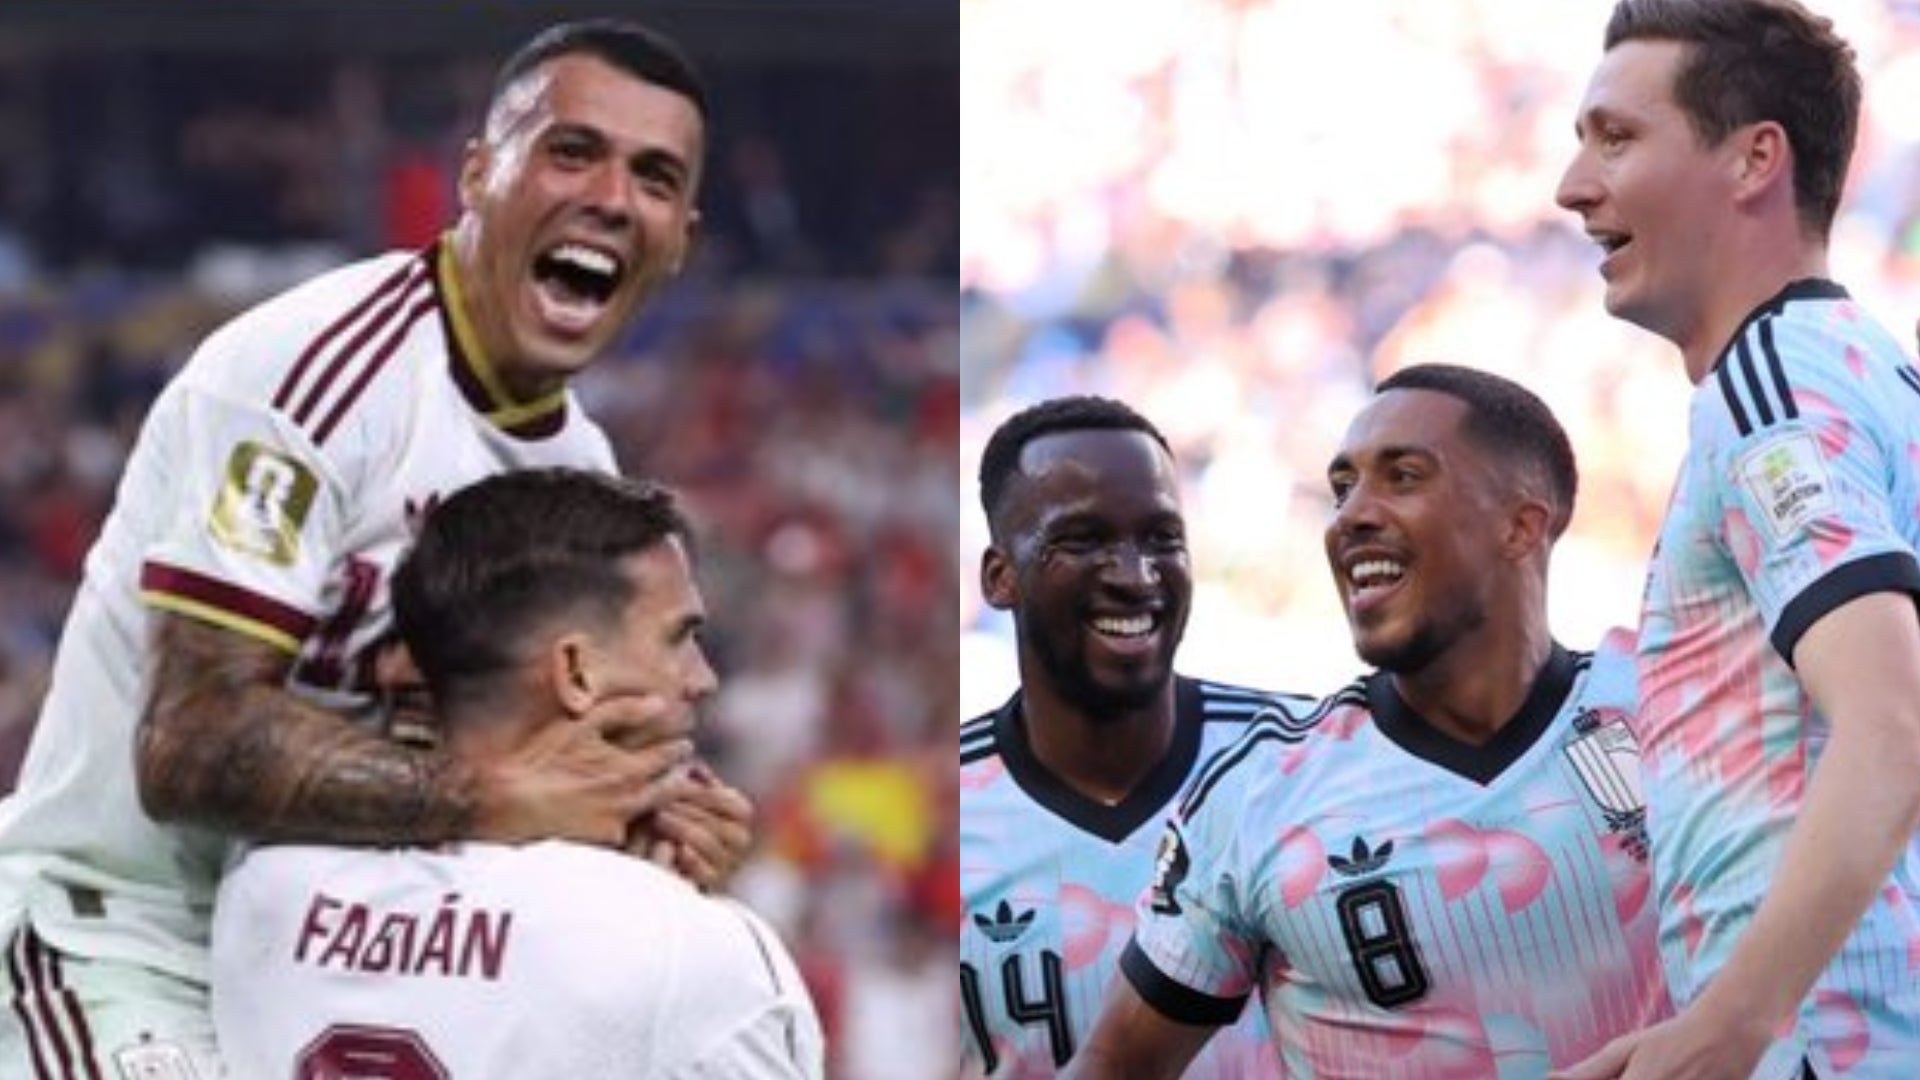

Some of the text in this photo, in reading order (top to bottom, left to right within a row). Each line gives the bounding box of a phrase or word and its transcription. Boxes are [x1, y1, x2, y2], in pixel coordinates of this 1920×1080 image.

[295, 893, 513, 980] FABIÁN
[1337, 880, 1428, 1007] 8
[960, 950, 1076, 1076] 14
